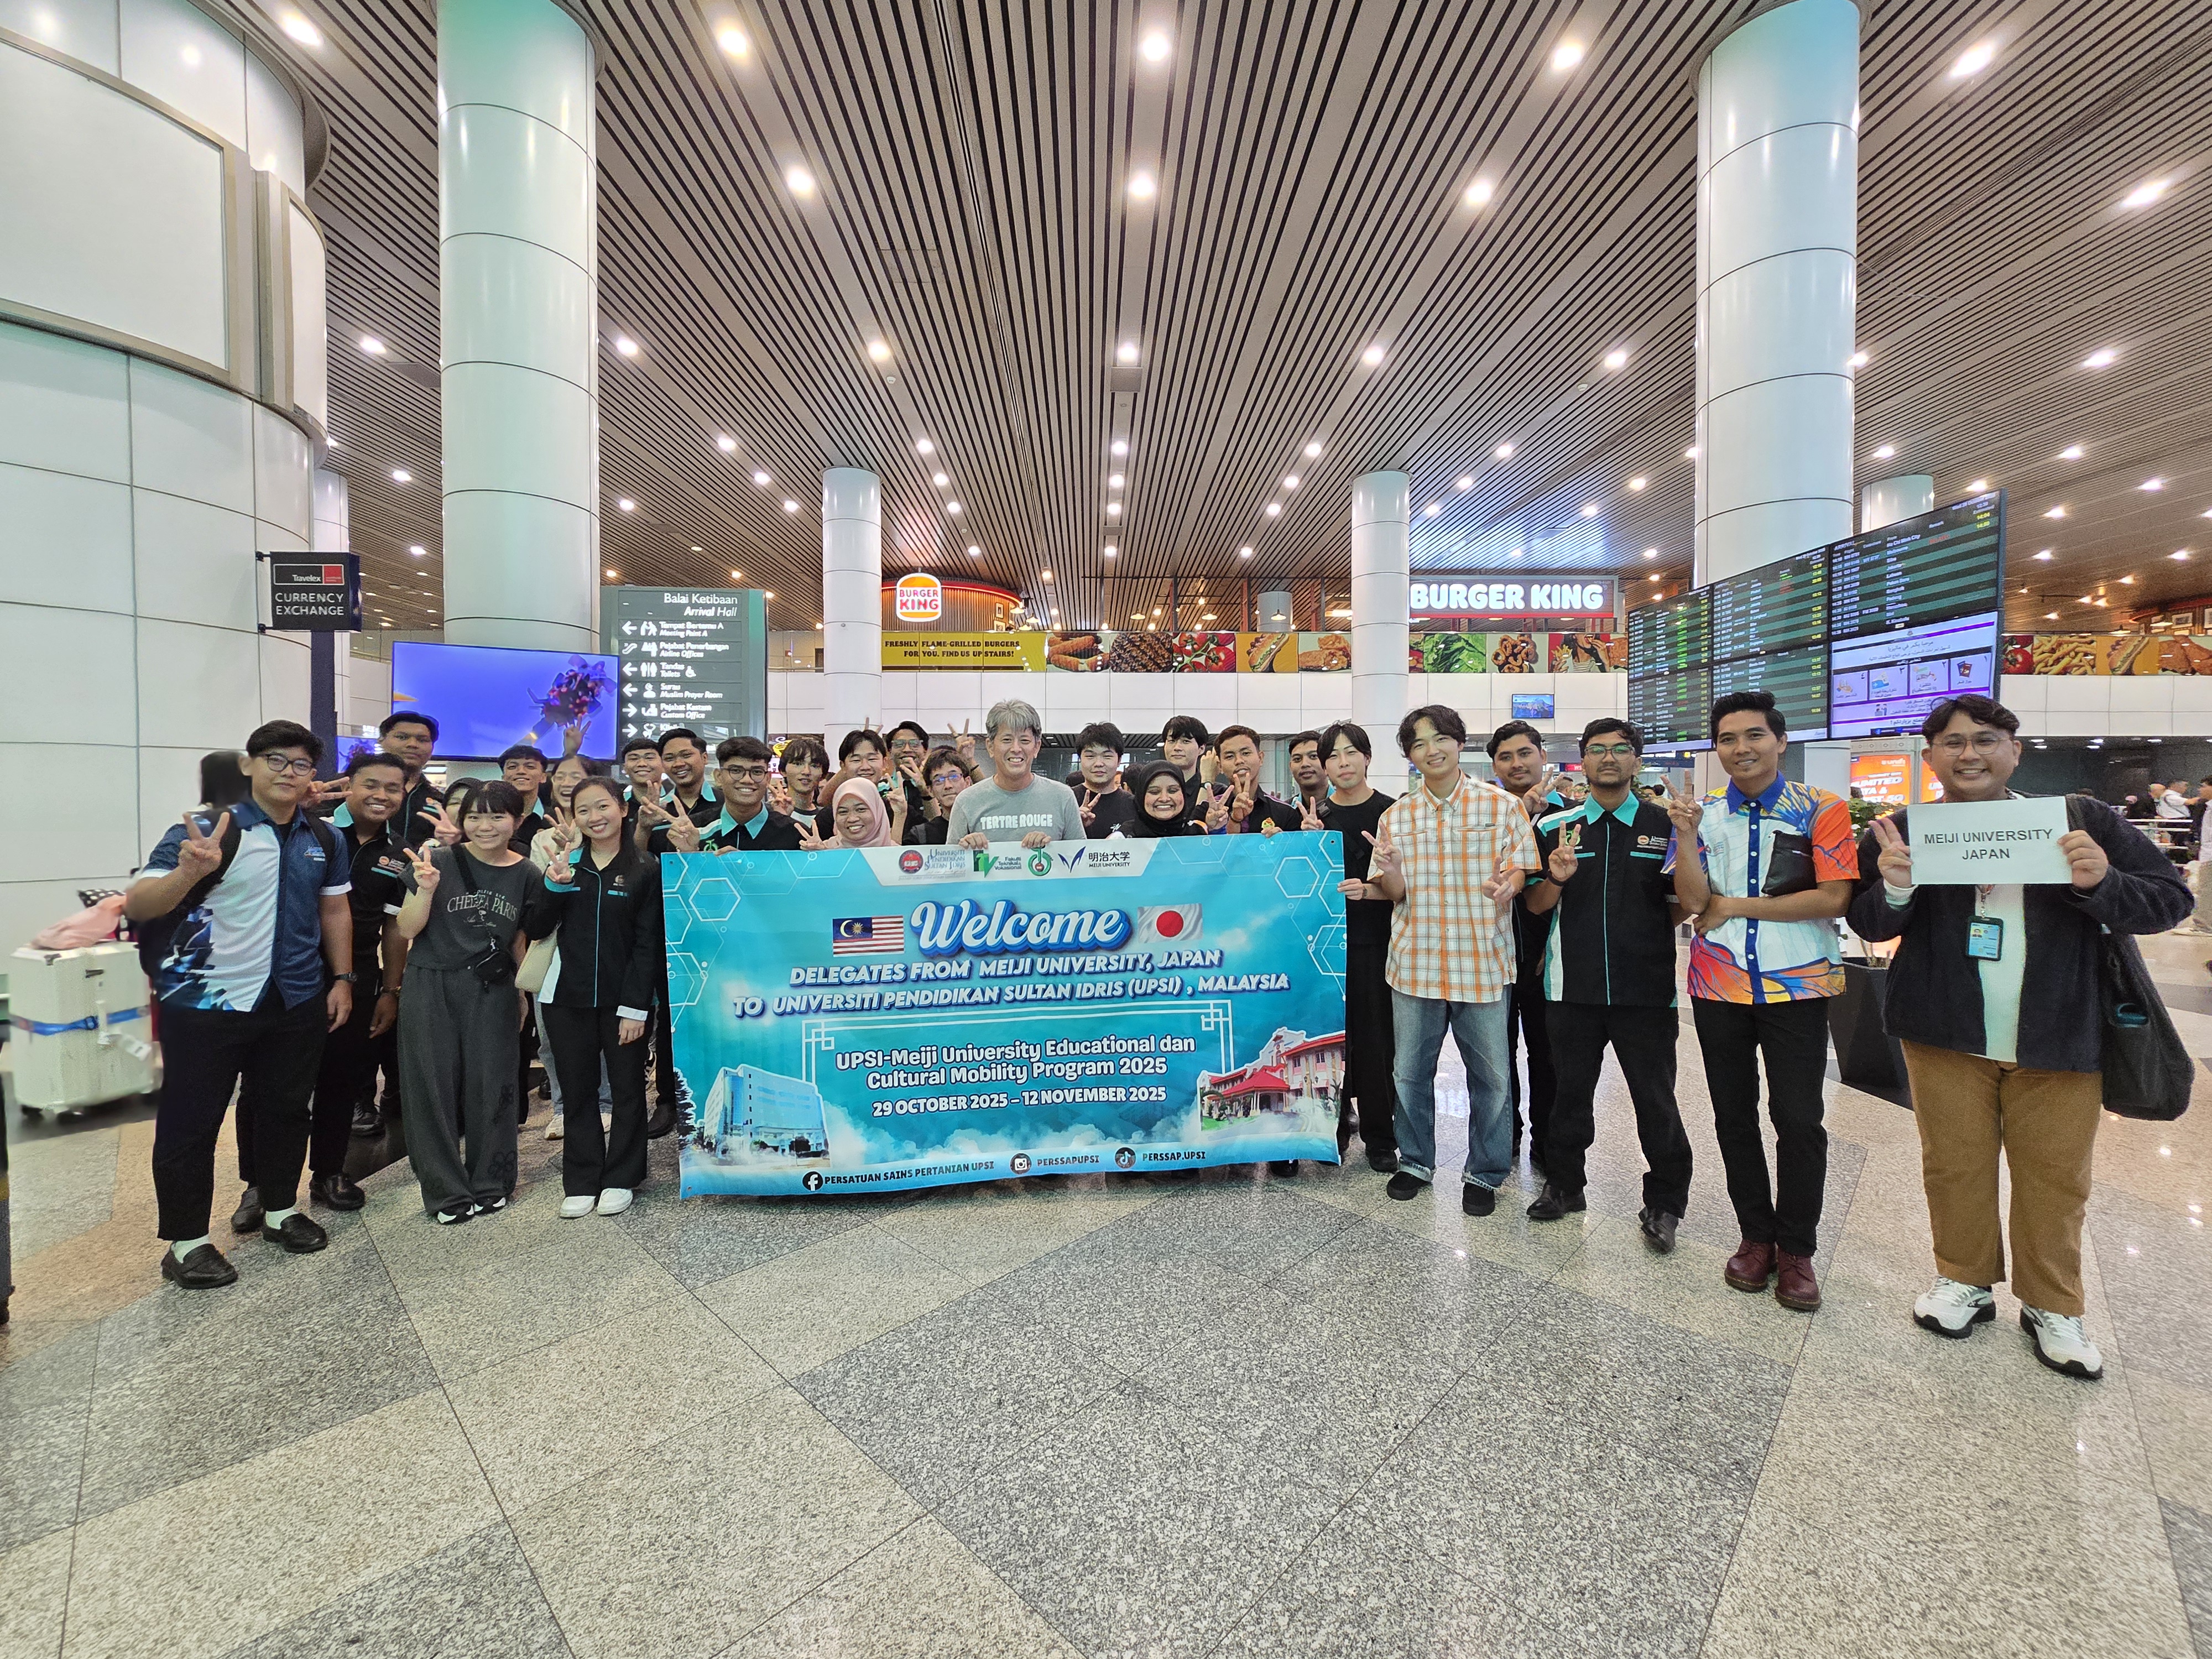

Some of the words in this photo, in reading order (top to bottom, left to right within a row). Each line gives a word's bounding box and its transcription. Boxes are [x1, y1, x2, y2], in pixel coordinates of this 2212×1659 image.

[292, 574, 321, 582] Travelex
[275, 593, 344, 603] CURRENCY
[664, 592, 689, 604] Balai
[692, 593, 738, 604] Ketibaan
[1410, 583, 1525, 609] BURGER
[1531, 583, 1604, 609] KING
[276, 606, 344, 615] EXCHANGE
[900, 599, 939, 610] KING
[684, 606, 716, 617] Arrival
[717, 607, 738, 617] Hall
[681, 650, 704, 659] Offices
[659, 662, 685, 670] Tandas
[684, 691, 705, 700] Prayer
[686, 711, 706, 720] Office
[980, 815, 1018, 830] TERTRE
[1019, 814, 1053, 828] ROUGE
[1924, 833, 1959, 844] MEIJI
[1963, 828, 2053, 843] UNIVERSITY
[1088, 852, 1130, 862] 明治大学
[1962, 848, 2010, 860] JAPAN
[925, 861, 948, 870] SULTAN
[950, 861, 966, 870] IDRIS
[491, 897, 518, 921] PARIS
[911, 899, 1124, 950] Welcome
[790, 964, 905, 985] DELEGATES
[910, 960, 969, 979] FROM
[979, 958, 1030, 976] MEIJI
[1035, 952, 1152, 973] UNIVERSITY,
[1157, 950, 1221, 967] JAPAN
[733, 997, 764, 1016] TO
[772, 993, 880, 1014] UNIVERSITI
[884, 986, 999, 1008] PENDIDIKAN
[1004, 983, 1072, 1001] SULTAN
[1075, 982, 1124, 998] IDRIS
[1128, 977, 1182, 998] (UPSI)
[1198, 974, 1290, 991] MALAYSIA
[836, 1046, 938, 1070] UPSI-Meiji
[942, 1040, 1042, 1063] University
[1045, 1035, 1155, 1056] Educational
[1160, 1034, 1196, 1052] dan
[868, 1068, 945, 1088] Cultural
[951, 1062, 1027, 1084] Mobility
[1032, 1058, 1115, 1079] Program
[1119, 1057, 1168, 1074] 2025
[872, 1102, 893, 1117] 29
[895, 1095, 967, 1114] OCTOBER
[971, 1093, 1008, 1109] 2025
[1023, 1091, 1038, 1106] 12
[1042, 1087, 1125, 1104] NOVEMBER
[1129, 1086, 1166, 1101] 2025
[825, 1175, 881, 1185] PERSATUAN
[883, 1170, 913, 1181] SAINS
[915, 1164, 969, 1177] PERTANIAN
[971, 1161, 994, 1171] UPSI
